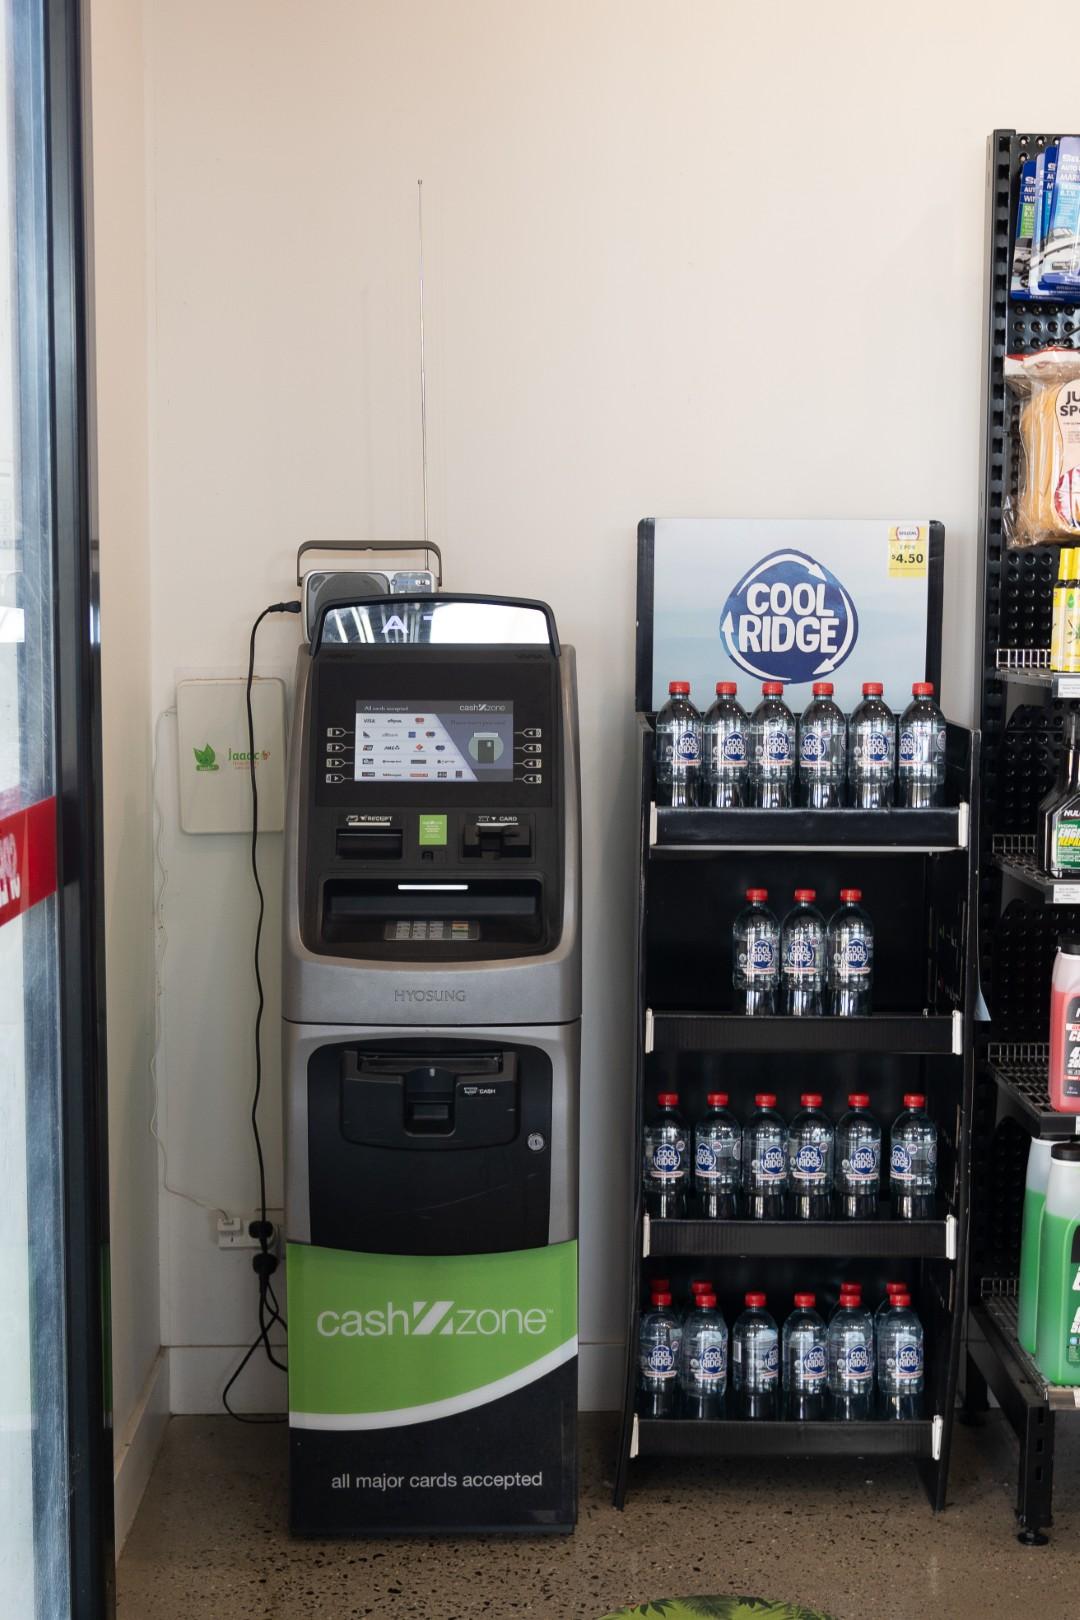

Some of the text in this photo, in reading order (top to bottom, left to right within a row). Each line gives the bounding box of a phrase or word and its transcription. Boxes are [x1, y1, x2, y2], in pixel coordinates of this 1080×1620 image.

[1060, 405, 1080, 416] SP
[746, 582, 834, 617] COOL
[738, 614, 840, 653] RIDGE
[394, 990, 467, 1002] HYOSUNG
[657, 1149, 676, 1157] COOL
[766, 1152, 783, 1160] COOL
[800, 1151, 819, 1159] COOL
[855, 1152, 873, 1160] COOL
[656, 1157, 678, 1166] RIDGE
[799, 1158, 820, 1167] RIDGE
[853, 1159, 875, 1168] RIDGE
[652, 1350, 670, 1358] COOL
[704, 1352, 721, 1360] COOL
[850, 1351, 867, 1359] COOL
[901, 1351, 917, 1359] COOL
[650, 1357, 672, 1366] RIDGE
[331, 1472, 543, 1491] all major cards accepted
